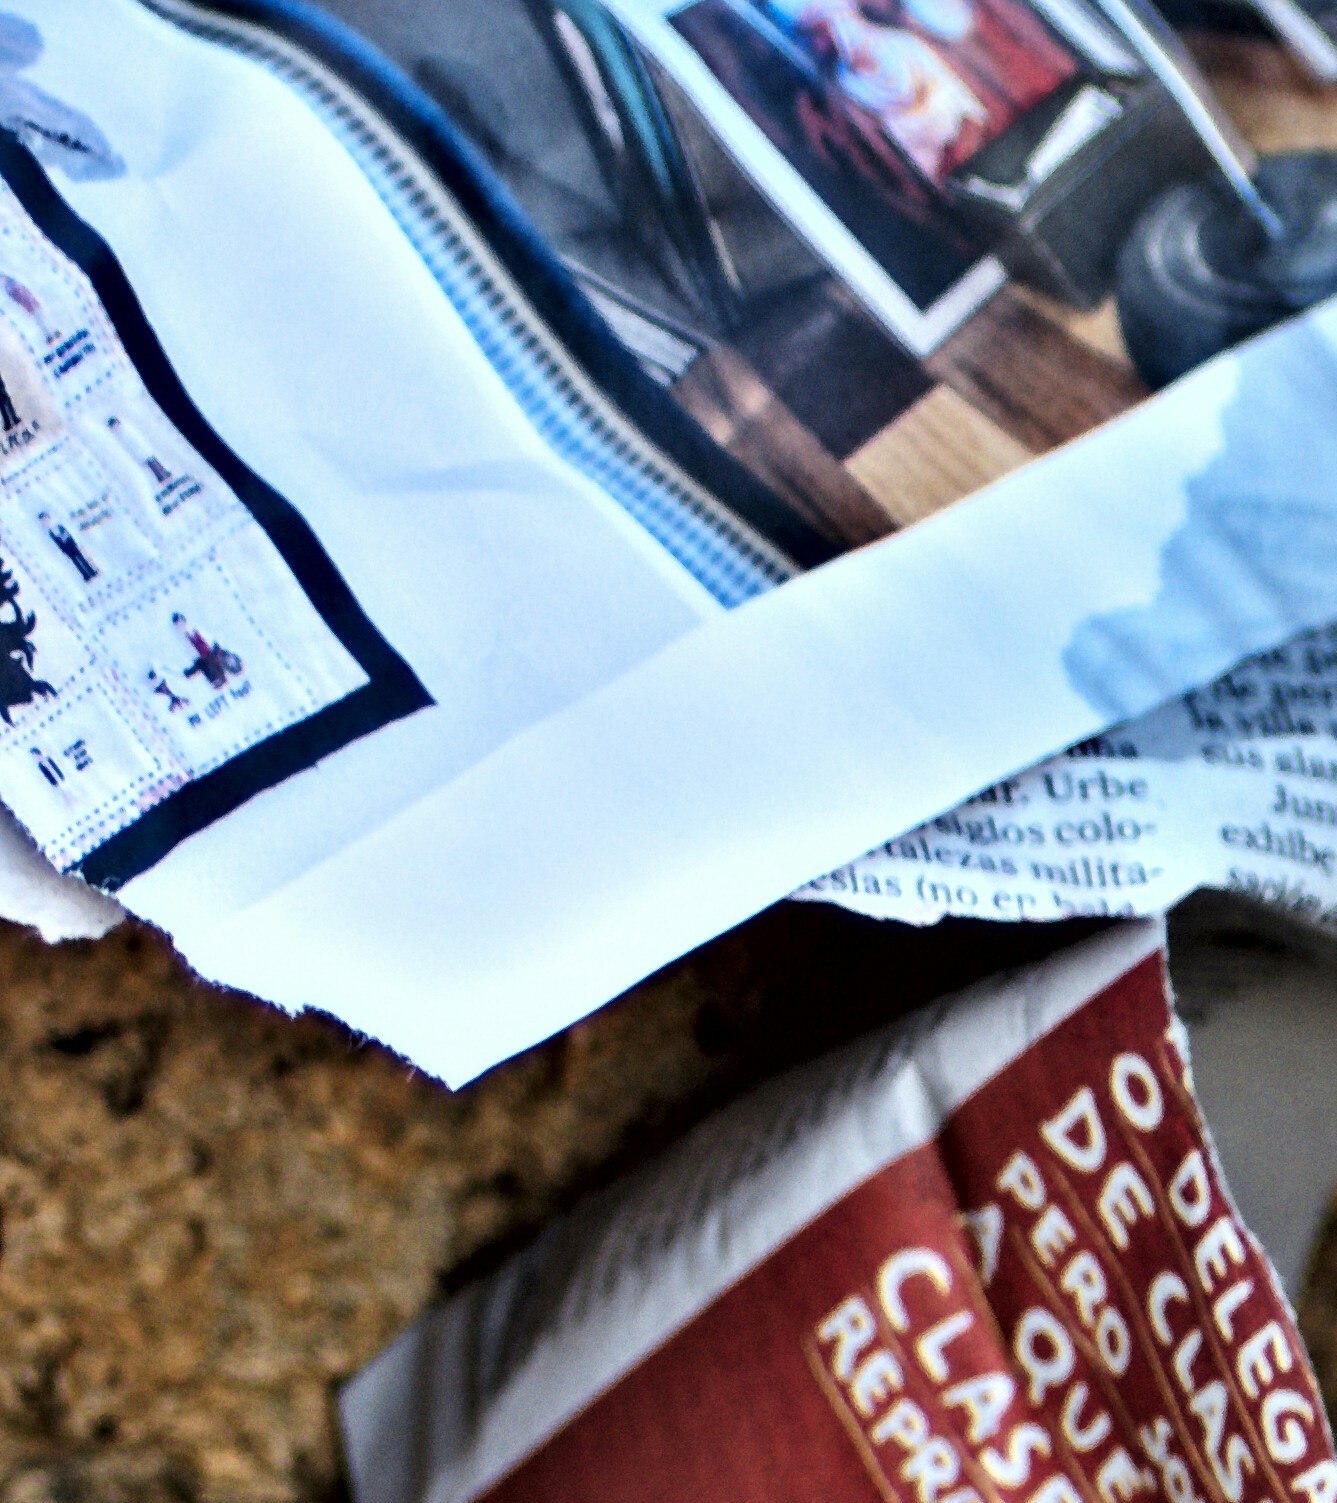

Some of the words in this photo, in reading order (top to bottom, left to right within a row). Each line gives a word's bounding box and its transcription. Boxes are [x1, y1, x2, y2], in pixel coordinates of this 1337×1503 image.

[1042, 770, 1149, 804] Urbe
[1041, 1085, 1157, 1251] DE
[997, 1148, 1131, 1377] PERO
